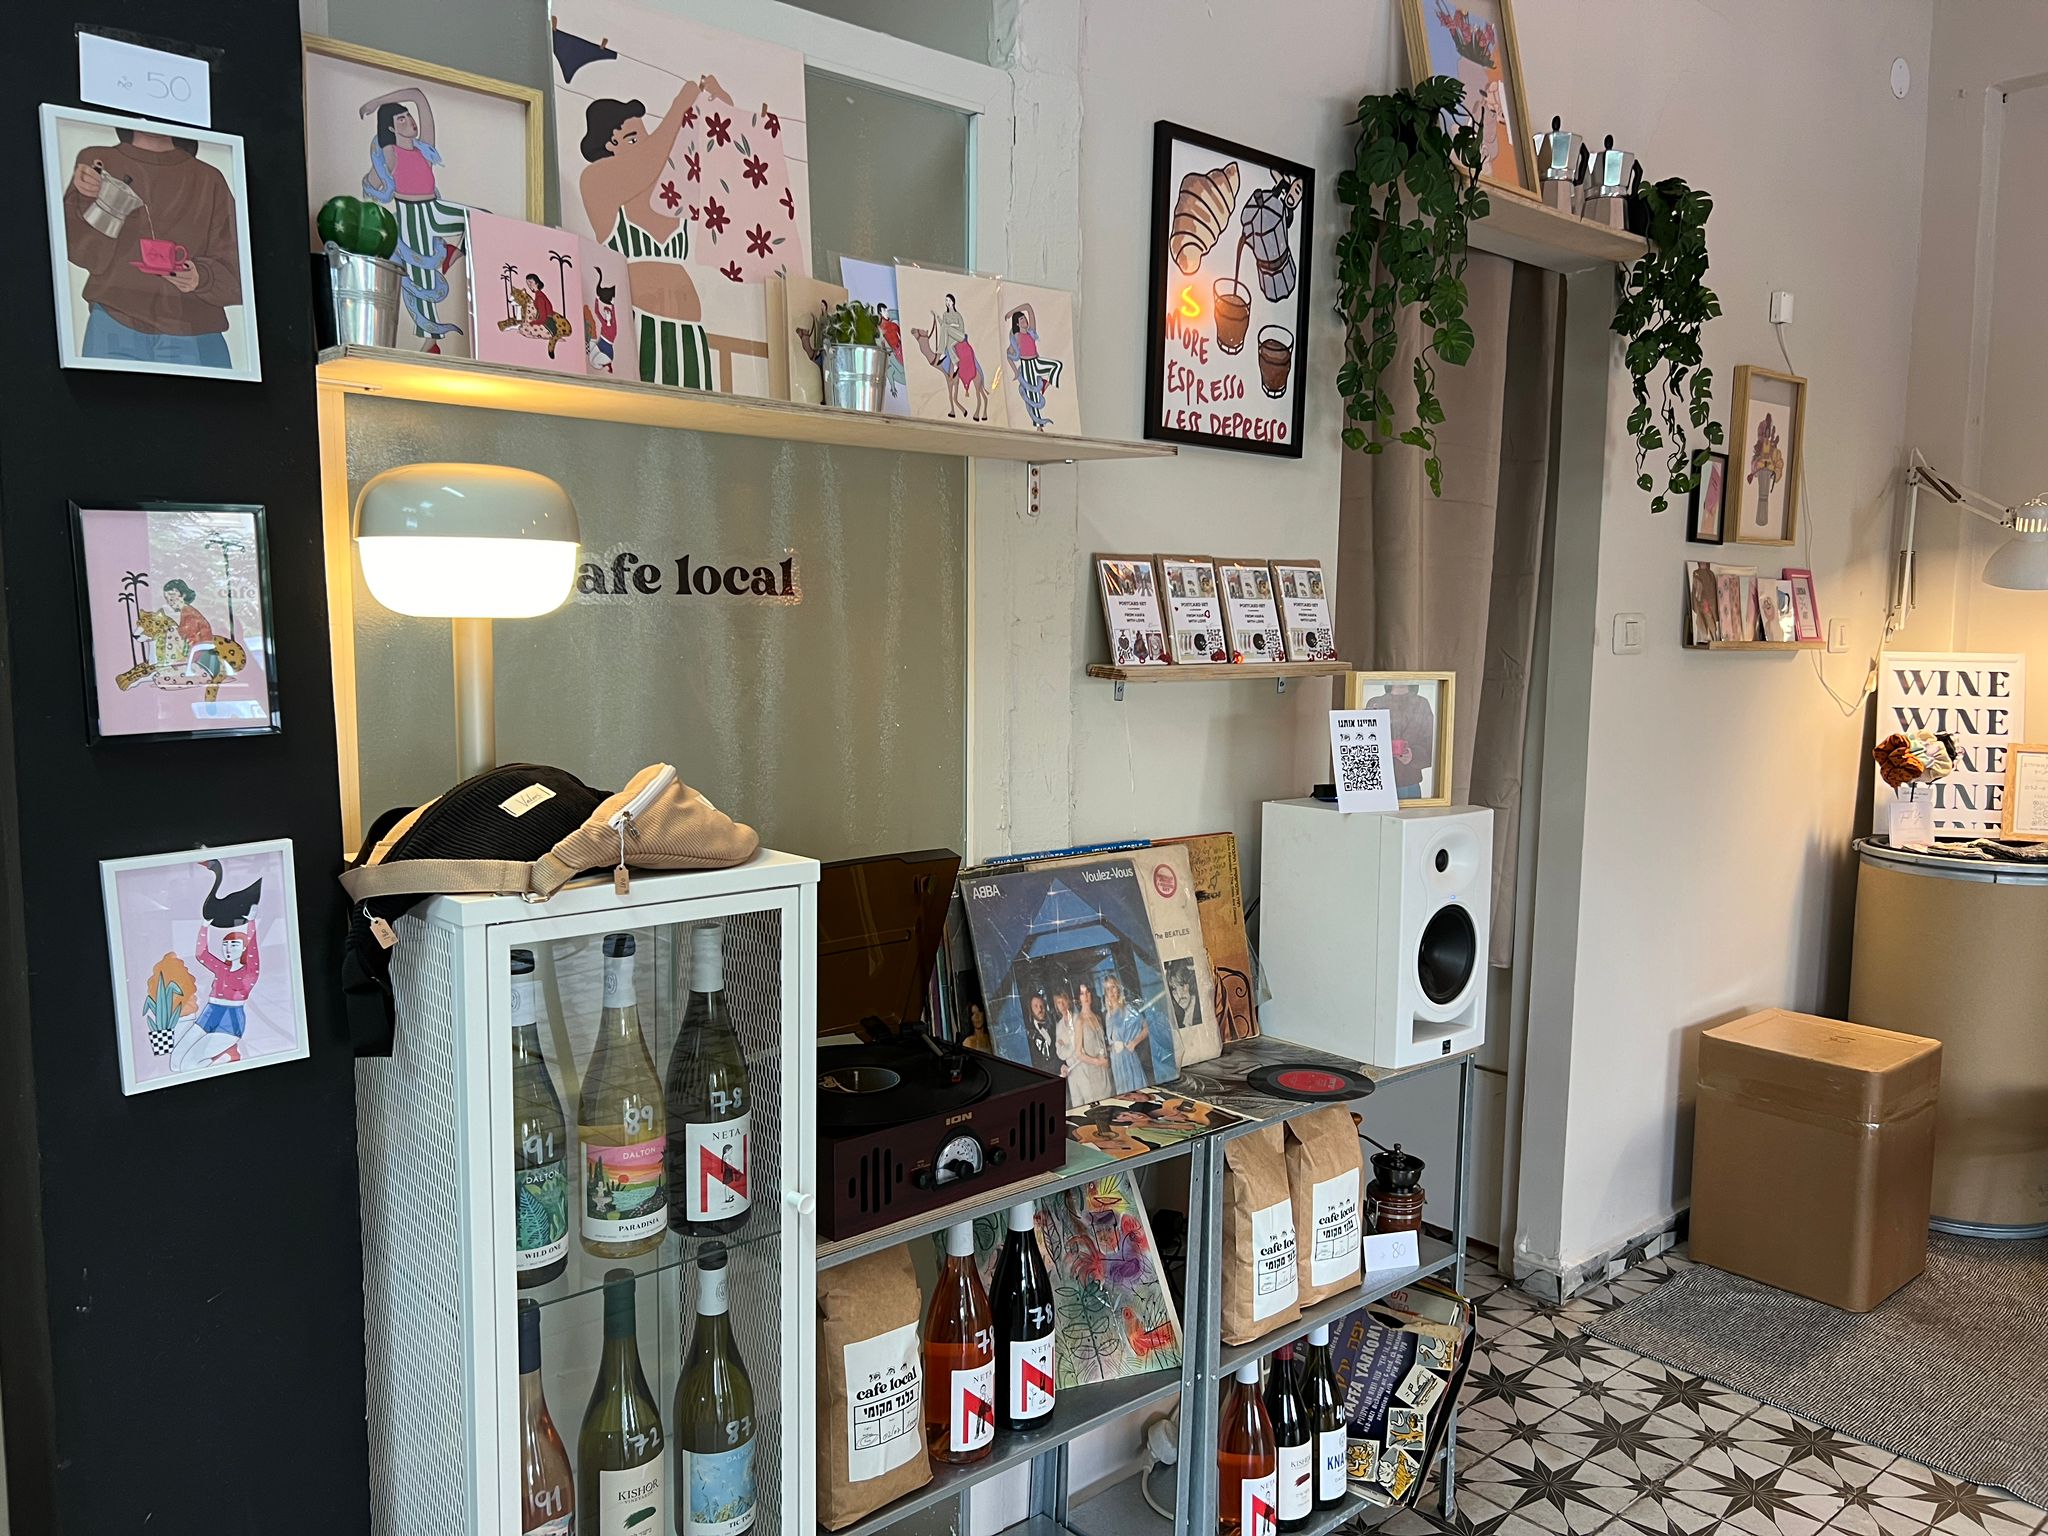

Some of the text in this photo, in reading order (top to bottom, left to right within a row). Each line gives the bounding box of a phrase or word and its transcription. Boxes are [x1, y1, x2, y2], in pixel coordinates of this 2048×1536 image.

[146, 72, 191, 102] 50
[1165, 307, 1209, 365] MORE
[1167, 359, 1245, 405] ESPRESSO
[1210, 413, 1287, 442] DEPRESSO
[576, 552, 795, 596] afe local
[1893, 669, 2010, 698] WINE
[1338, 719, 1355, 728] אותנו
[1892, 706, 2009, 735] WINE
[1954, 746, 2008, 773] NE
[1081, 866, 1134, 883] Voulez-Vous
[972, 884, 1001, 900] ABBA
[1164, 928, 1190, 938] BEATLES
[711, 1087, 743, 1115] 78
[625, 1104, 653, 1135] 89
[945, 1112, 973, 1126] ION
[712, 1128, 741, 1141] NETA
[523, 1132, 554, 1164] 91
[622, 1146, 656, 1160] DALTON
[525, 1170, 560, 1184] DALTON
[1318, 1203, 1356, 1225] cafe local
[524, 1247, 547, 1260] WILD
[1260, 1242, 1283, 1256] cafe
[1028, 1304, 1053, 1330] 78
[1031, 1342, 1052, 1356] NETA
[1355, 1325, 1383, 1378] YARKONI
[856, 1366, 917, 1400] cafe local
[863, 1400, 893, 1418] מקומי
[725, 1415, 752, 1444] 87
[535, 1485, 562, 1516] 91
[617, 1478, 659, 1502] KISHOR
